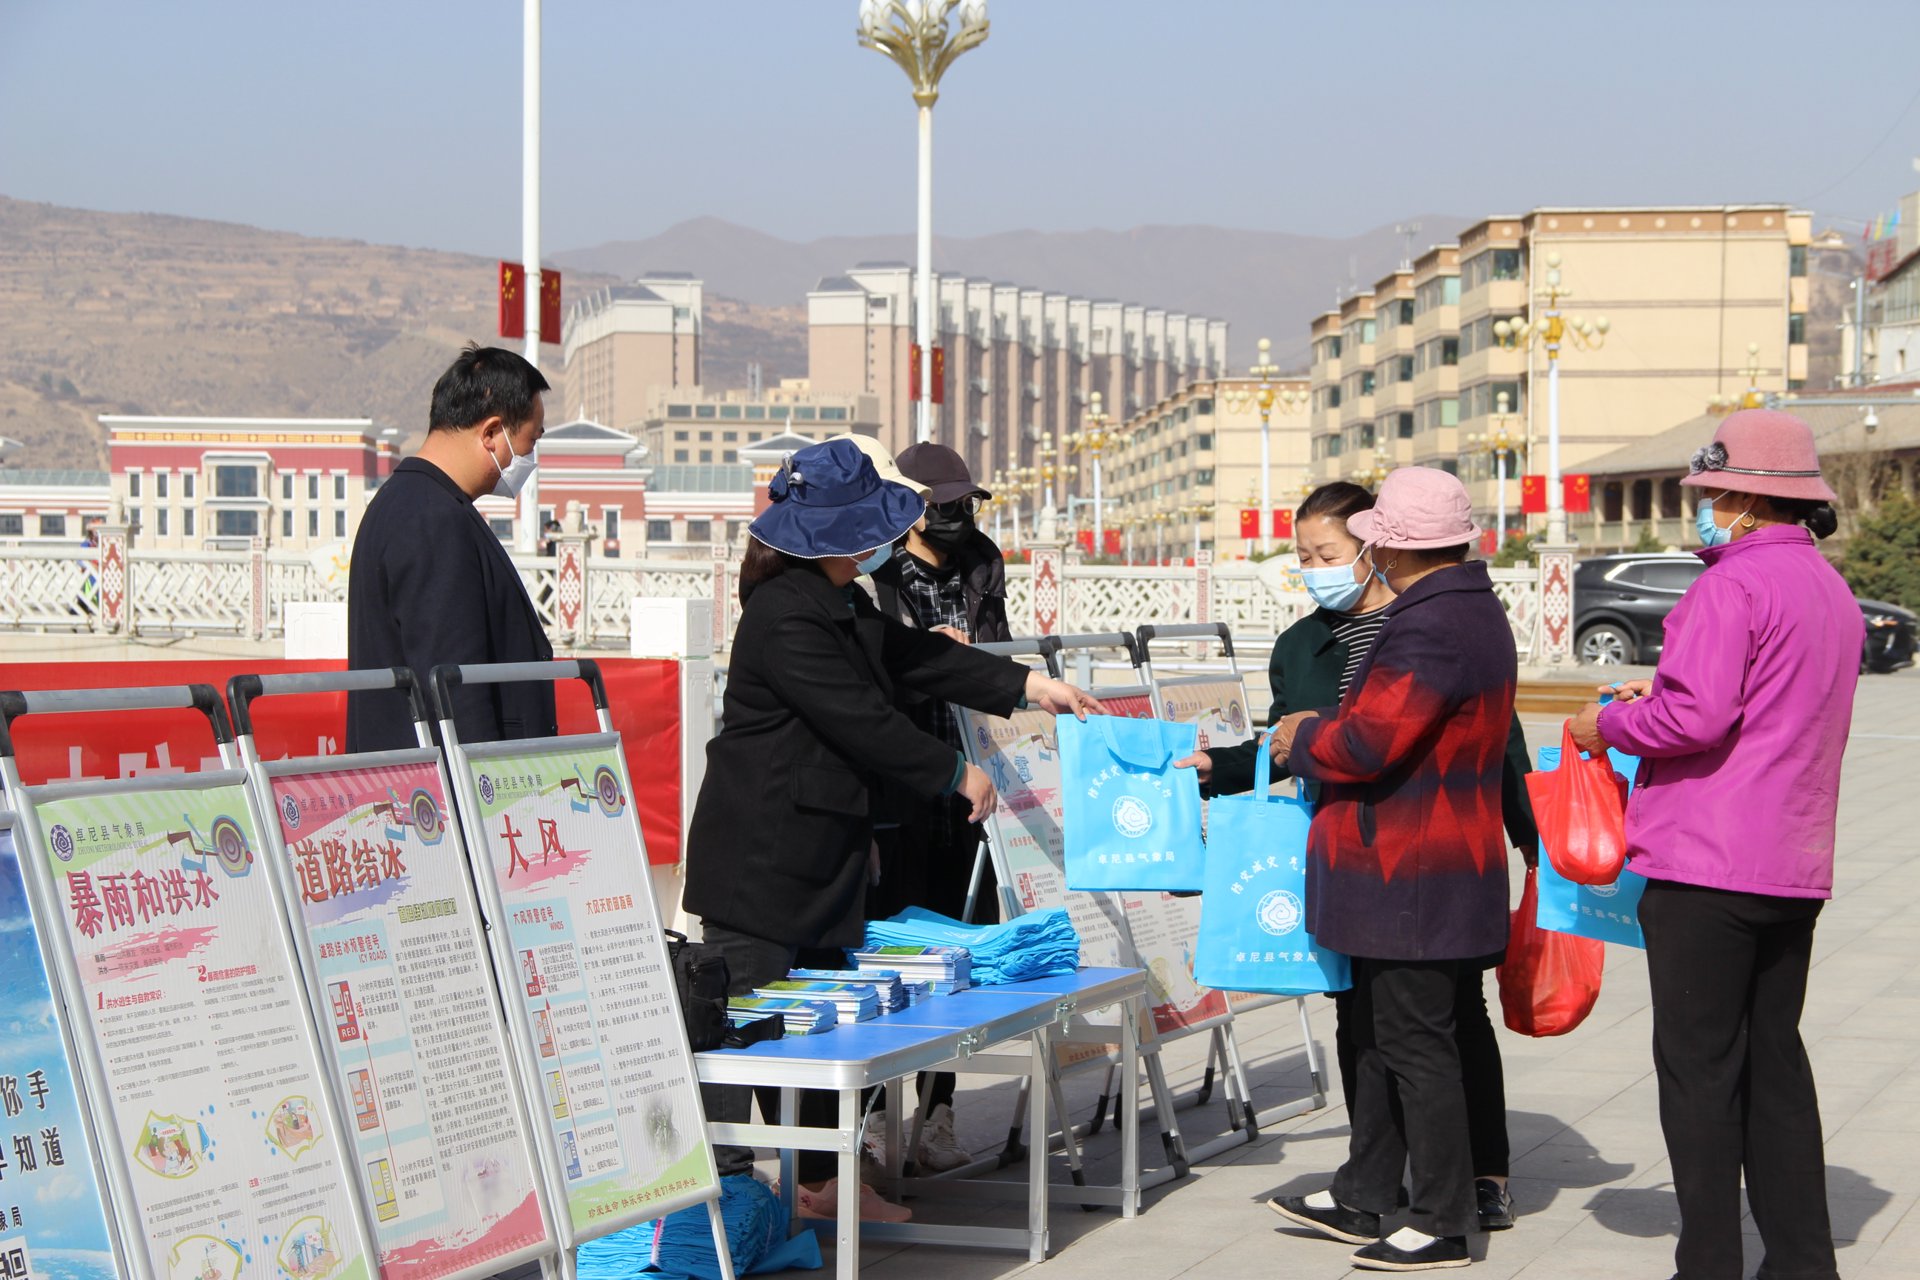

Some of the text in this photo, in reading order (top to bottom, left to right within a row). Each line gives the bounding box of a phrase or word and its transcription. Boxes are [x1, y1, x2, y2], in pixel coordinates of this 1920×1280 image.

[495, 774, 543, 790] 卓尼县气象局
[76, 822, 145, 843] 卓尼县气象局
[500, 814, 567, 879] 大风
[1098, 851, 1175, 864] 卓尼县气象局
[293, 838, 406, 906] 道路结冰
[66, 869, 220, 939] 暴雨和洪水
[513, 906, 554, 926] 大风预警信号
[319, 933, 380, 959] 道路结冰预警信号
[359, 949, 388, 963] ICY ROADS
[1235, 952, 1318, 963] 卓尼县气象局
[529, 984, 540, 994] RED
[341, 1028, 357, 1037] RED
